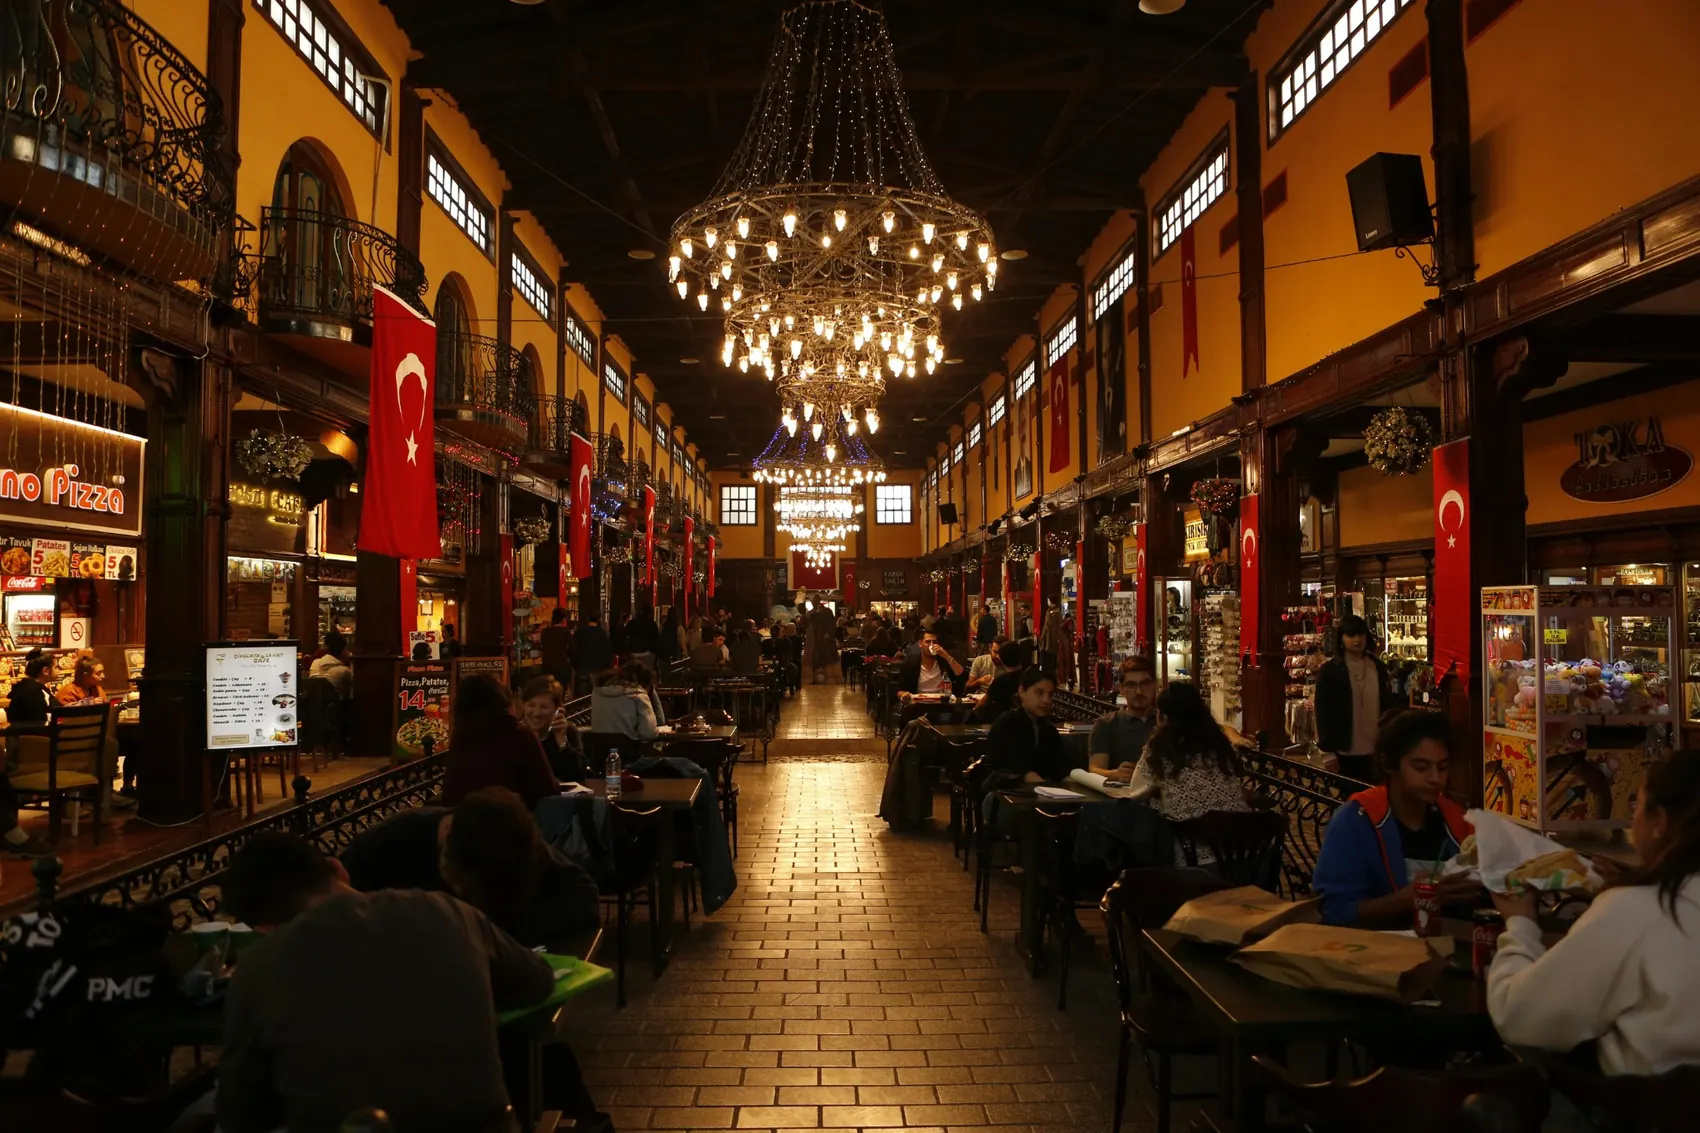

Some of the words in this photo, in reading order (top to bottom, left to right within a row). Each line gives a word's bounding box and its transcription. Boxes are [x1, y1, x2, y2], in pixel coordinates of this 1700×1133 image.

[1574, 416, 1665, 467] TOKA
[51, 464, 124, 514] Pizza
[9, 537, 31, 548] Tavuk
[36, 540, 67, 551] Patates
[33, 550, 44, 565] 5
[71, 553, 81, 568] 5
[107, 556, 117, 569] 5
[33, 567, 43, 575] TL
[71, 569, 80, 578] TL
[410, 632, 425, 641] Sufle
[425, 631, 436, 643] 5
[399, 689, 427, 711] 14
[87, 974, 157, 1003] PMC
